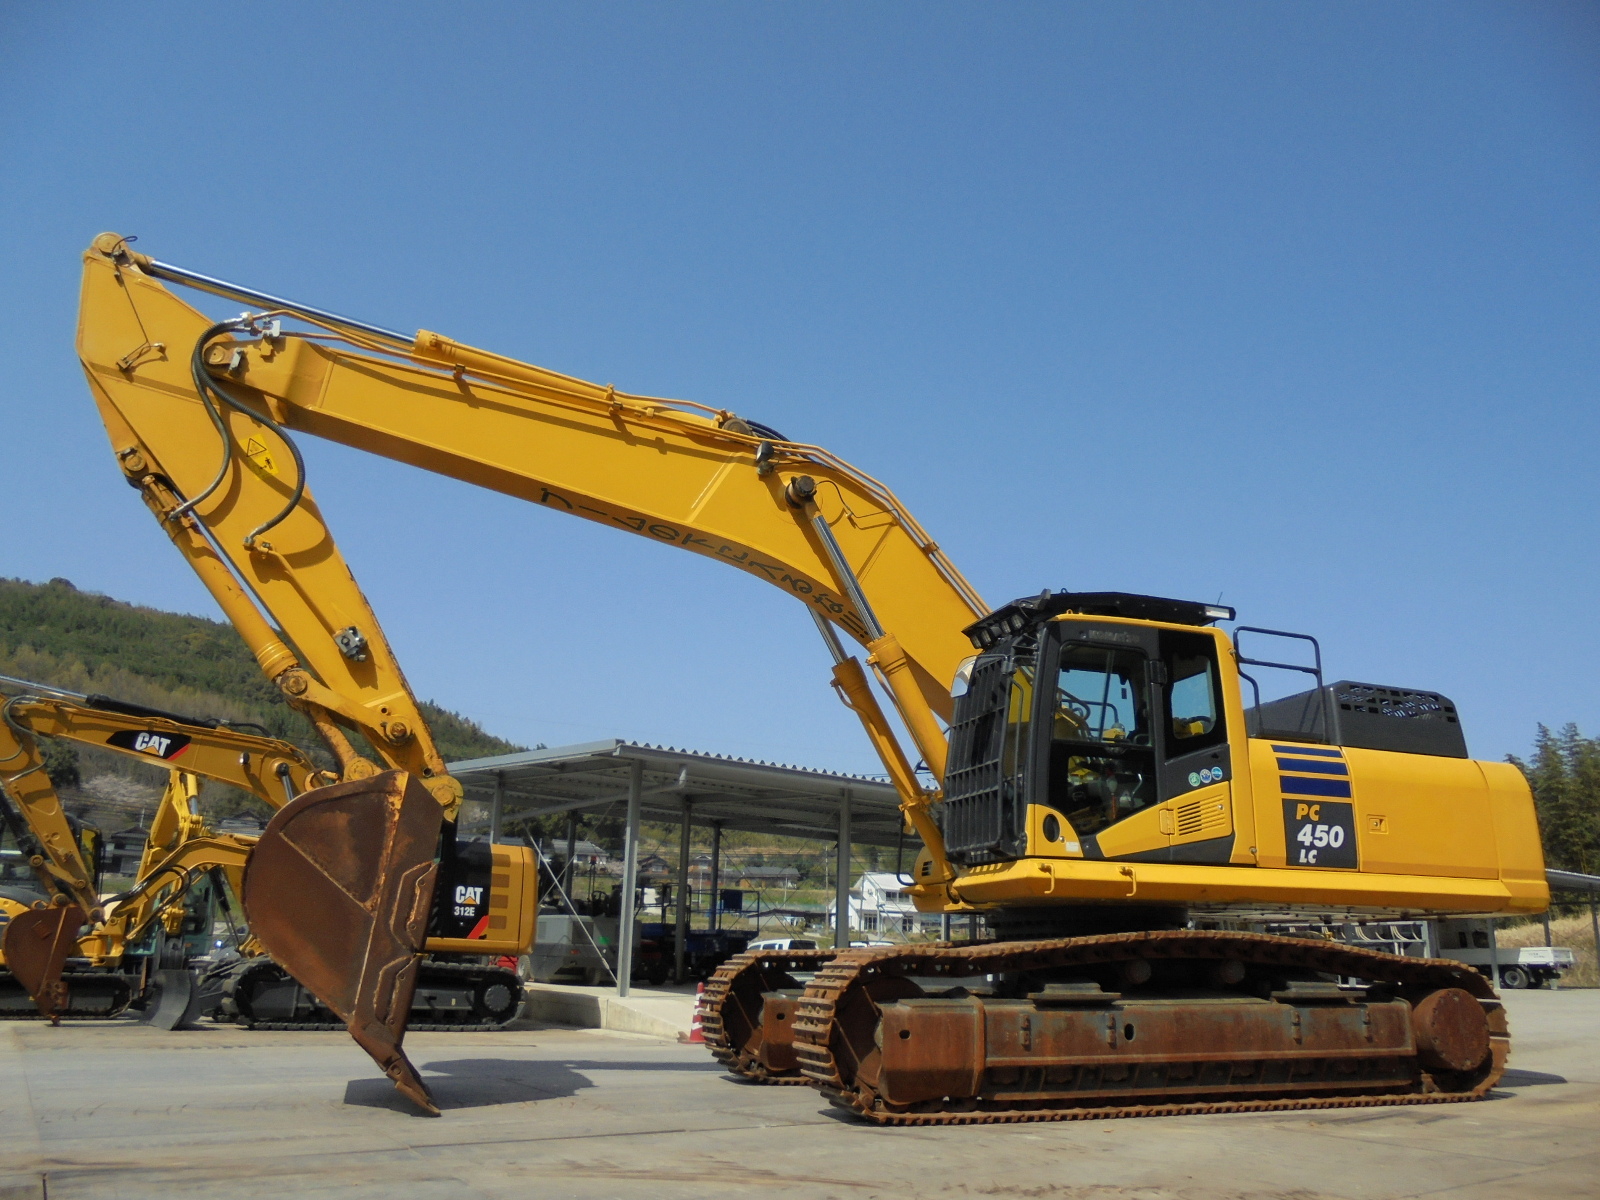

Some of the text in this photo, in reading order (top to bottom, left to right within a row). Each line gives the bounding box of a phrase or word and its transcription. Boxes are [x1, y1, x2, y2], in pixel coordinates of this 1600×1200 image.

[134, 732, 171, 757] CAT
[1296, 803, 1320, 821] PC
[1297, 823, 1345, 848] 450
[1299, 849, 1317, 864] LC
[455, 885, 483, 905] CAT
[454, 906, 475, 917] 312E
